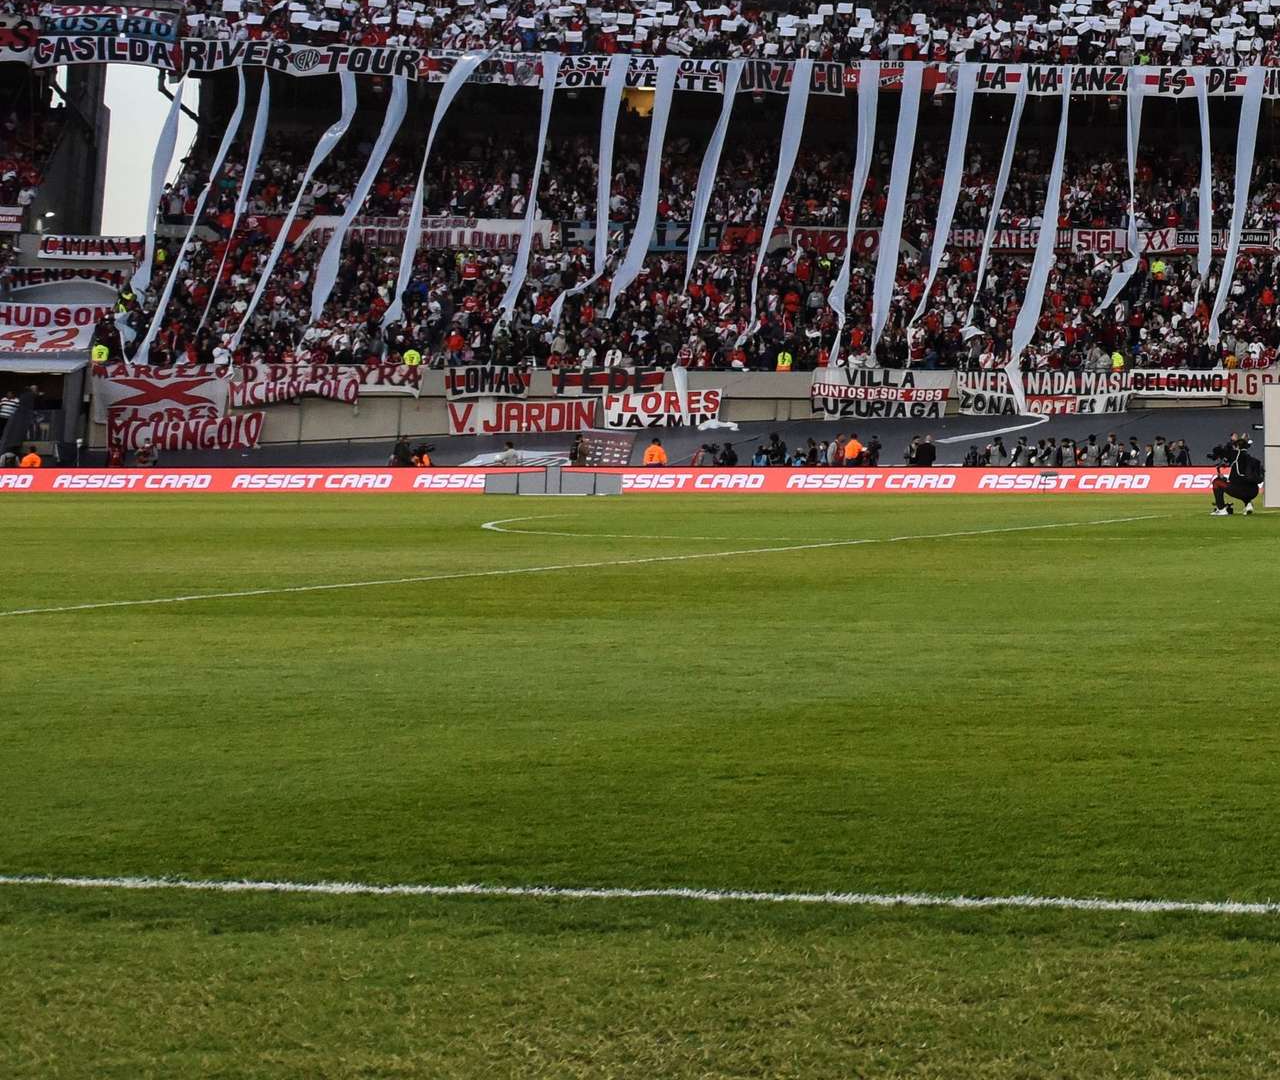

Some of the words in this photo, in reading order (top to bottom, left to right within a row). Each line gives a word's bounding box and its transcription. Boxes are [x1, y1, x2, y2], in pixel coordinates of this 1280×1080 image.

[35, 37, 172, 67] CASILDA
[183, 40, 291, 70] RIVER
[326, 46, 421, 78] TOUR
[977, 65, 1006, 90] LA
[1159, 68, 1187, 94] ES
[1208, 68, 1238, 93] DE
[1144, 229, 1169, 251] XX
[1, 328, 80, 348] 42
[92, 363, 230, 380] MARCELO
[451, 366, 526, 395] LOMAS
[844, 369, 915, 388] VILLA
[812, 384, 865, 399] JUNTOS
[867, 387, 904, 400] DESDE
[910, 389, 943, 401] 1989
[957, 371, 1007, 394] RIVER
[1026, 371, 1077, 395] NADA
[1133, 372, 1223, 393] BELGRANO
[605, 390, 720, 414] FLORES
[811, 398, 940, 418] LUZURIAGA
[960, 391, 1016, 416] ZONA
[53, 474, 143, 488] ASSIST
[146, 474, 211, 488] CARD
[232, 474, 324, 488] ASSIST
[326, 474, 392, 488] CARD
[413, 474, 486, 488] ASSIS
[622, 474, 692, 488] SSIST
[695, 474, 765, 488] CARD
[787, 474, 883, 488] ASSIST
[886, 474, 956, 488] CARD
[978, 474, 1076, 488] ASSIST
[1079, 474, 1150, 488] CARD
